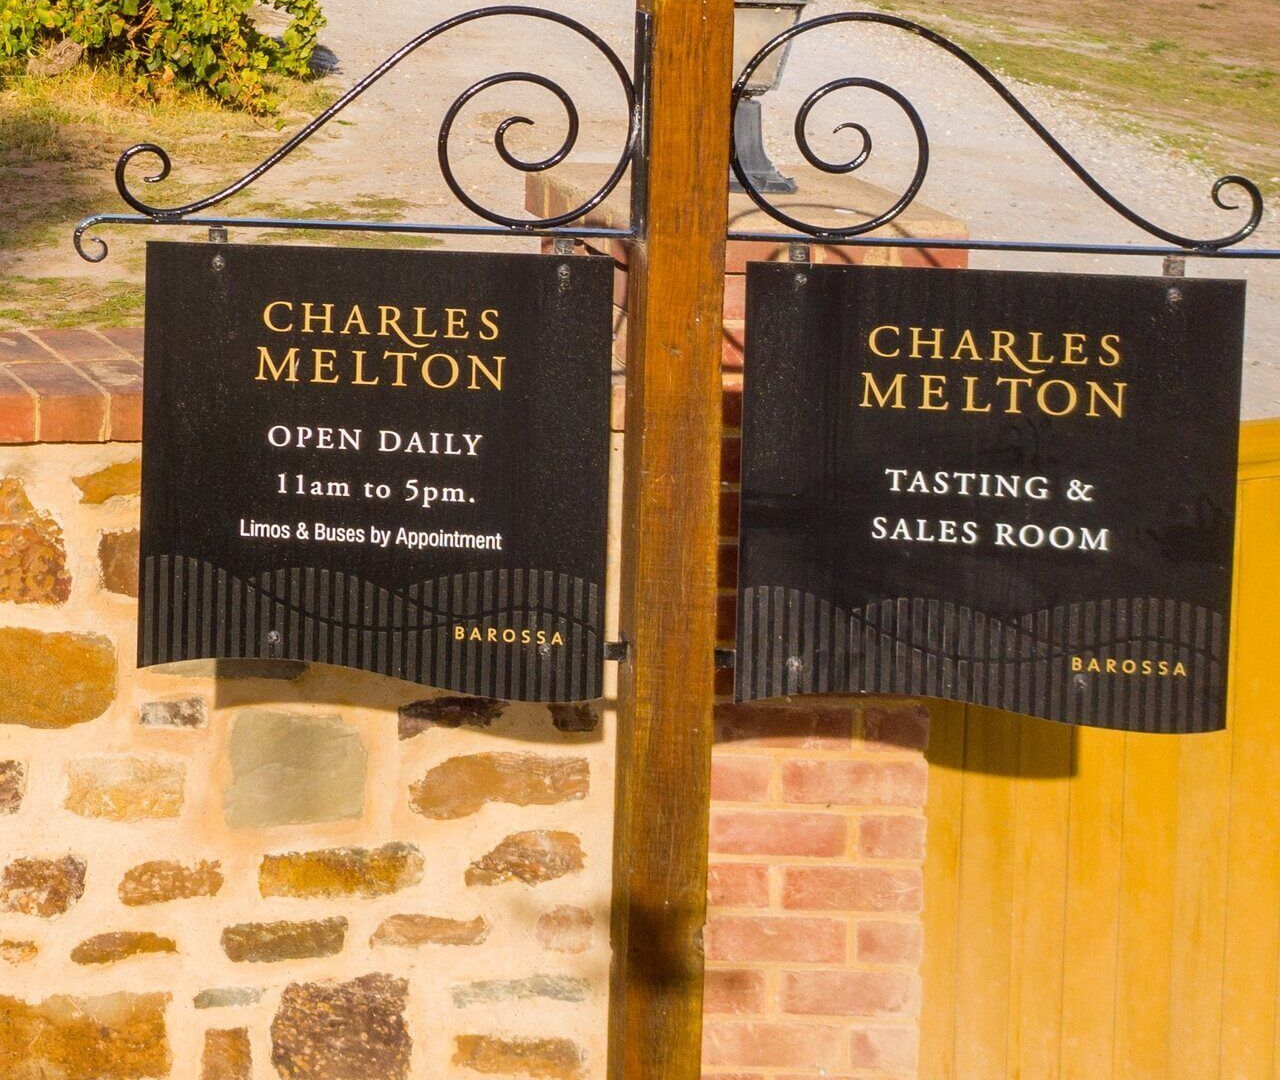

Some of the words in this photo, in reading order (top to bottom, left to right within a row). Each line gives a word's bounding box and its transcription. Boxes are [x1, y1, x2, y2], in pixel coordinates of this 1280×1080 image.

[262, 300, 499, 348] CHARLES
[868, 325, 1120, 374] CHARLES
[254, 345, 507, 391] MELTON
[858, 371, 1128, 418] MELTON
[267, 424, 363, 451] OPEN
[377, 430, 484, 456] DAILY
[277, 471, 351, 497] 11am
[363, 482, 391, 499] to
[404, 478, 475, 509] 5pm.
[884, 468, 1049, 500] TASTING
[1066, 478, 1094, 503] &
[239, 518, 291, 540] Limos
[295, 521, 310, 540] &
[314, 522, 366, 544] Buses
[370, 525, 392, 548] by
[394, 526, 503, 551] Appointment
[871, 516, 978, 545] SALES
[994, 522, 1110, 551] ROOM
[454, 625, 564, 646] BAROSSA
[1071, 656, 1187, 677] BAROSSA
